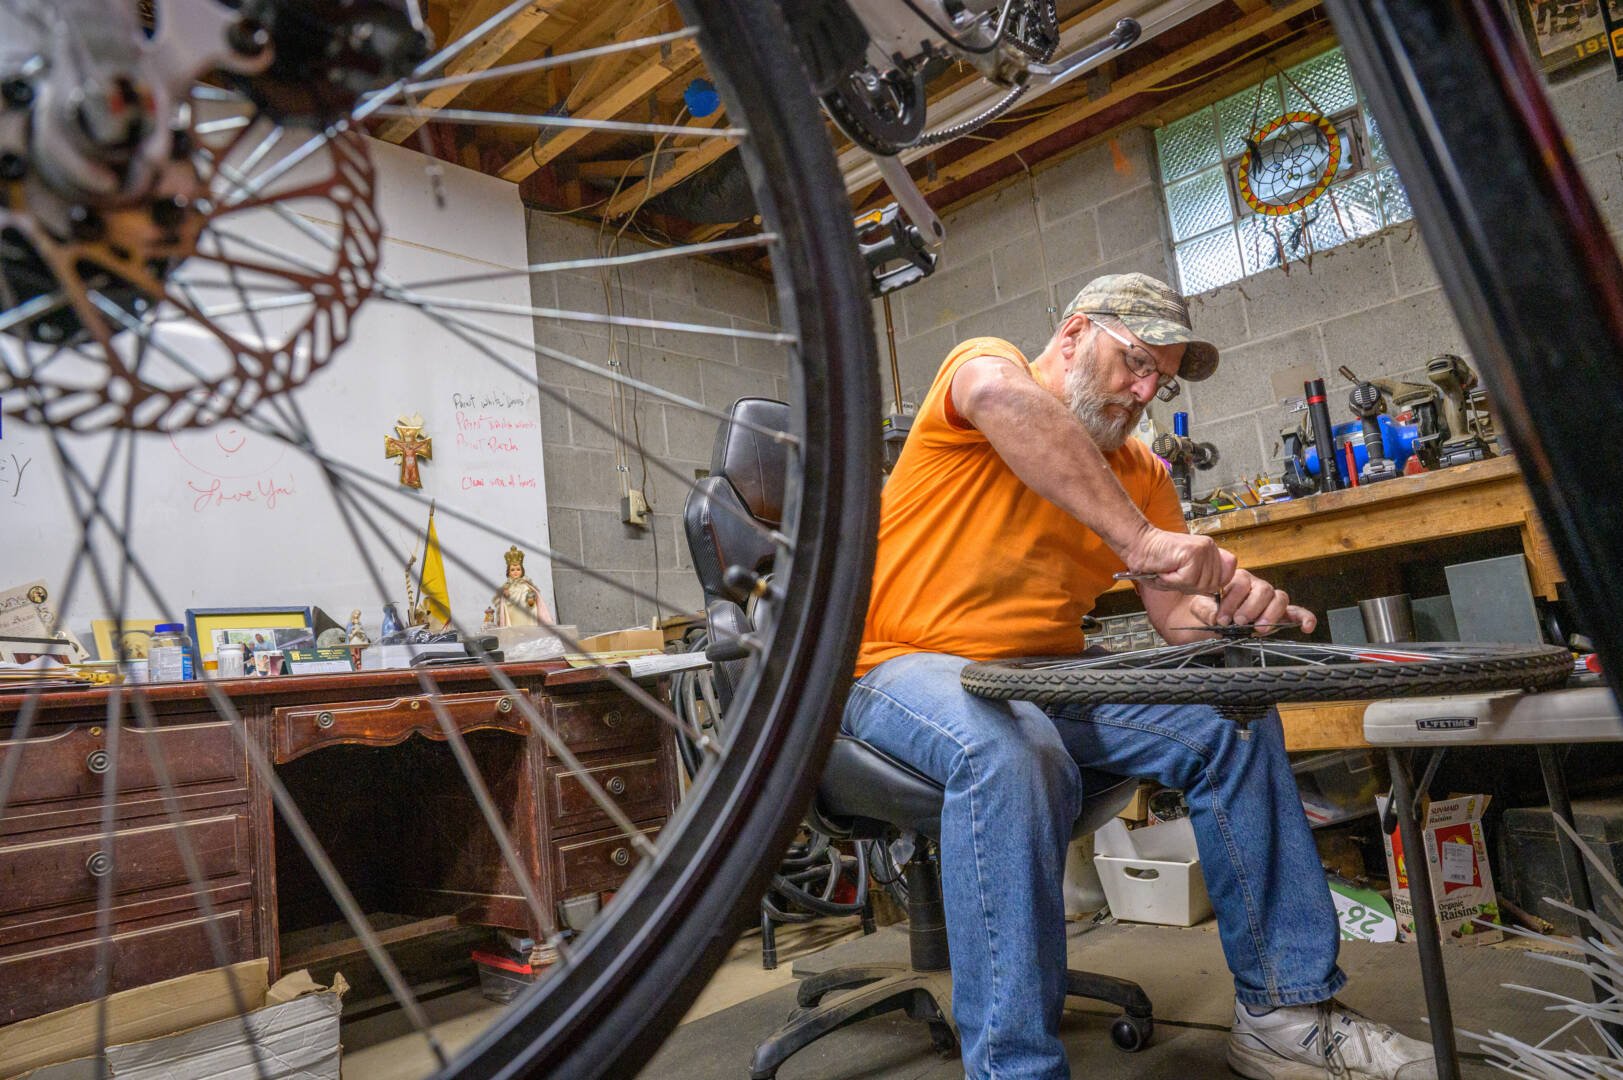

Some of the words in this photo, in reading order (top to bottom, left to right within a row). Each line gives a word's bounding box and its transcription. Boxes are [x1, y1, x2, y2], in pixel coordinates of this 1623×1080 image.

[188, 479, 256, 512] Love
[1395, 903, 1413, 915] Rais
[1438, 900, 1464, 911] Organic
[1440, 906, 1478, 921] Raisins
